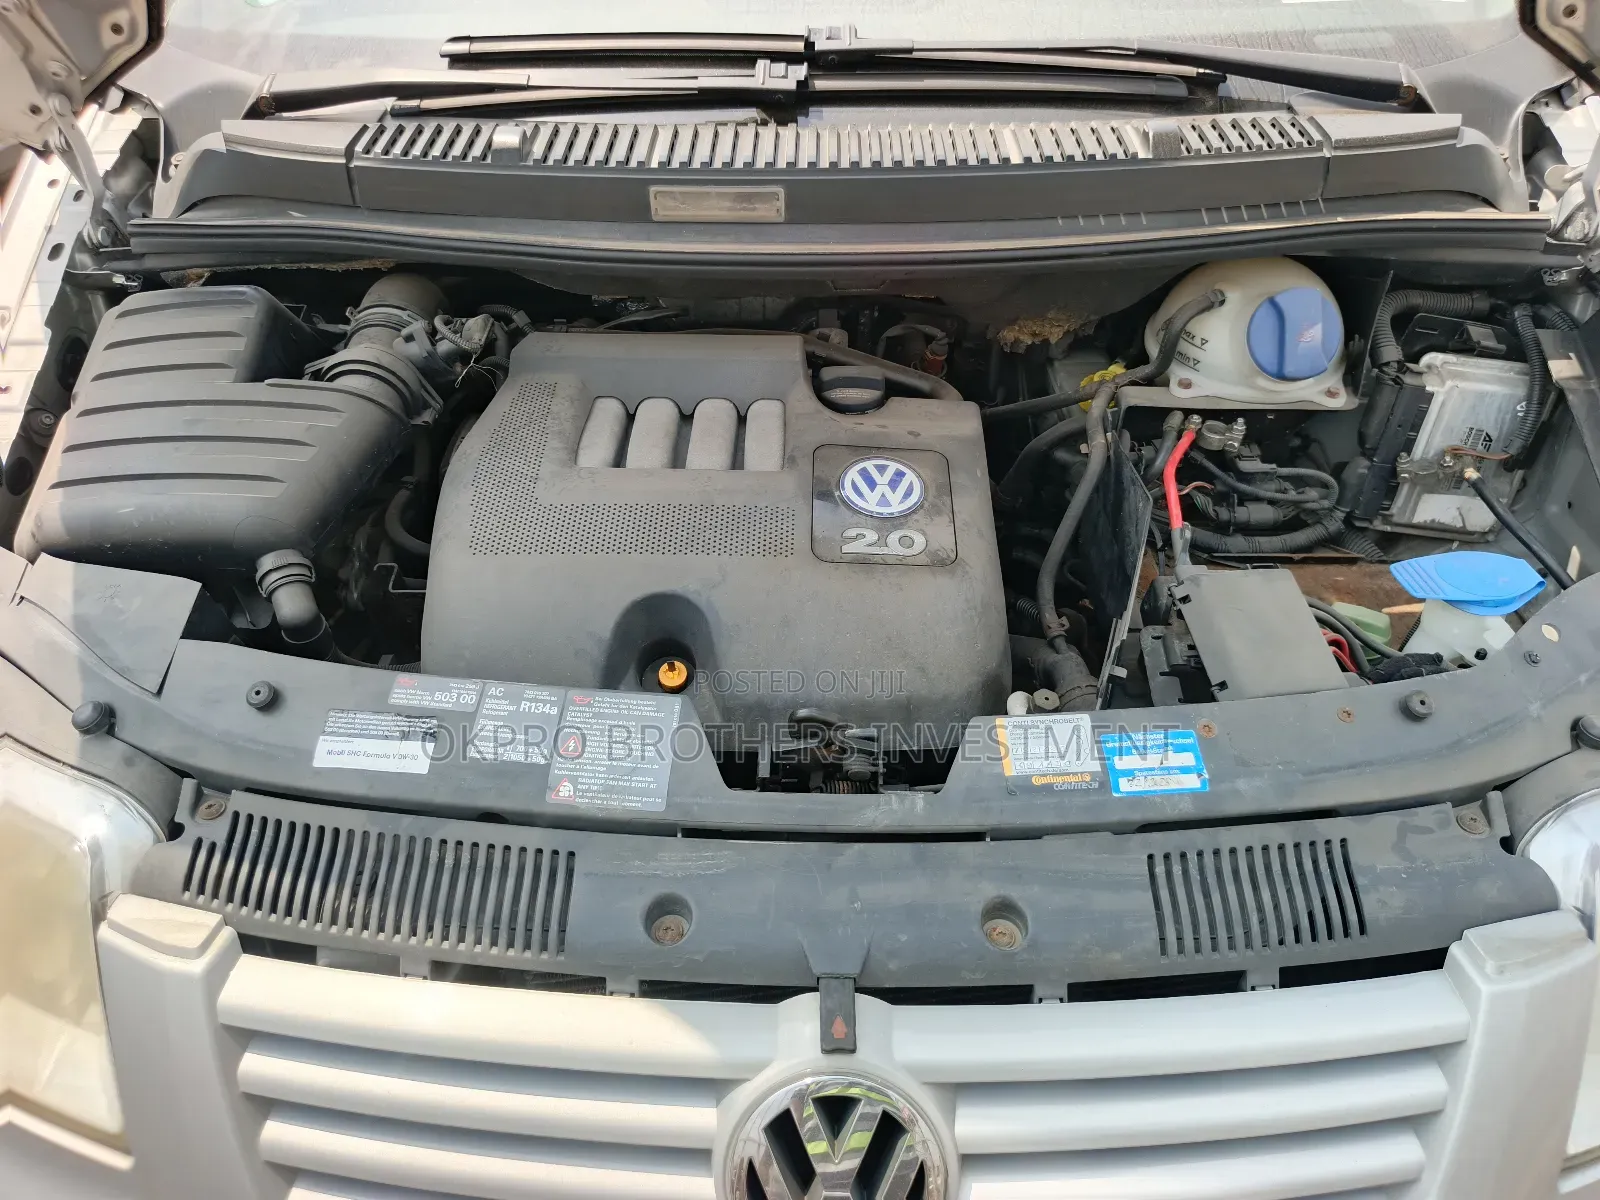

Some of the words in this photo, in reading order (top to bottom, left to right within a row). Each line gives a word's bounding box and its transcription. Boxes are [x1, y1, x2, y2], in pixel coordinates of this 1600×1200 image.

[1175, 350, 1190, 363] min
[488, 687, 504, 696] AC
[434, 691, 458, 702] 503
[460, 693, 477, 704] 00
[519, 700, 558, 715] R134a
[362, 751, 391, 759] Formula
[397, 753, 419, 761] 0W-30
[532, 756, 545, 765] 50g
[1032, 774, 1083, 785] Continental
